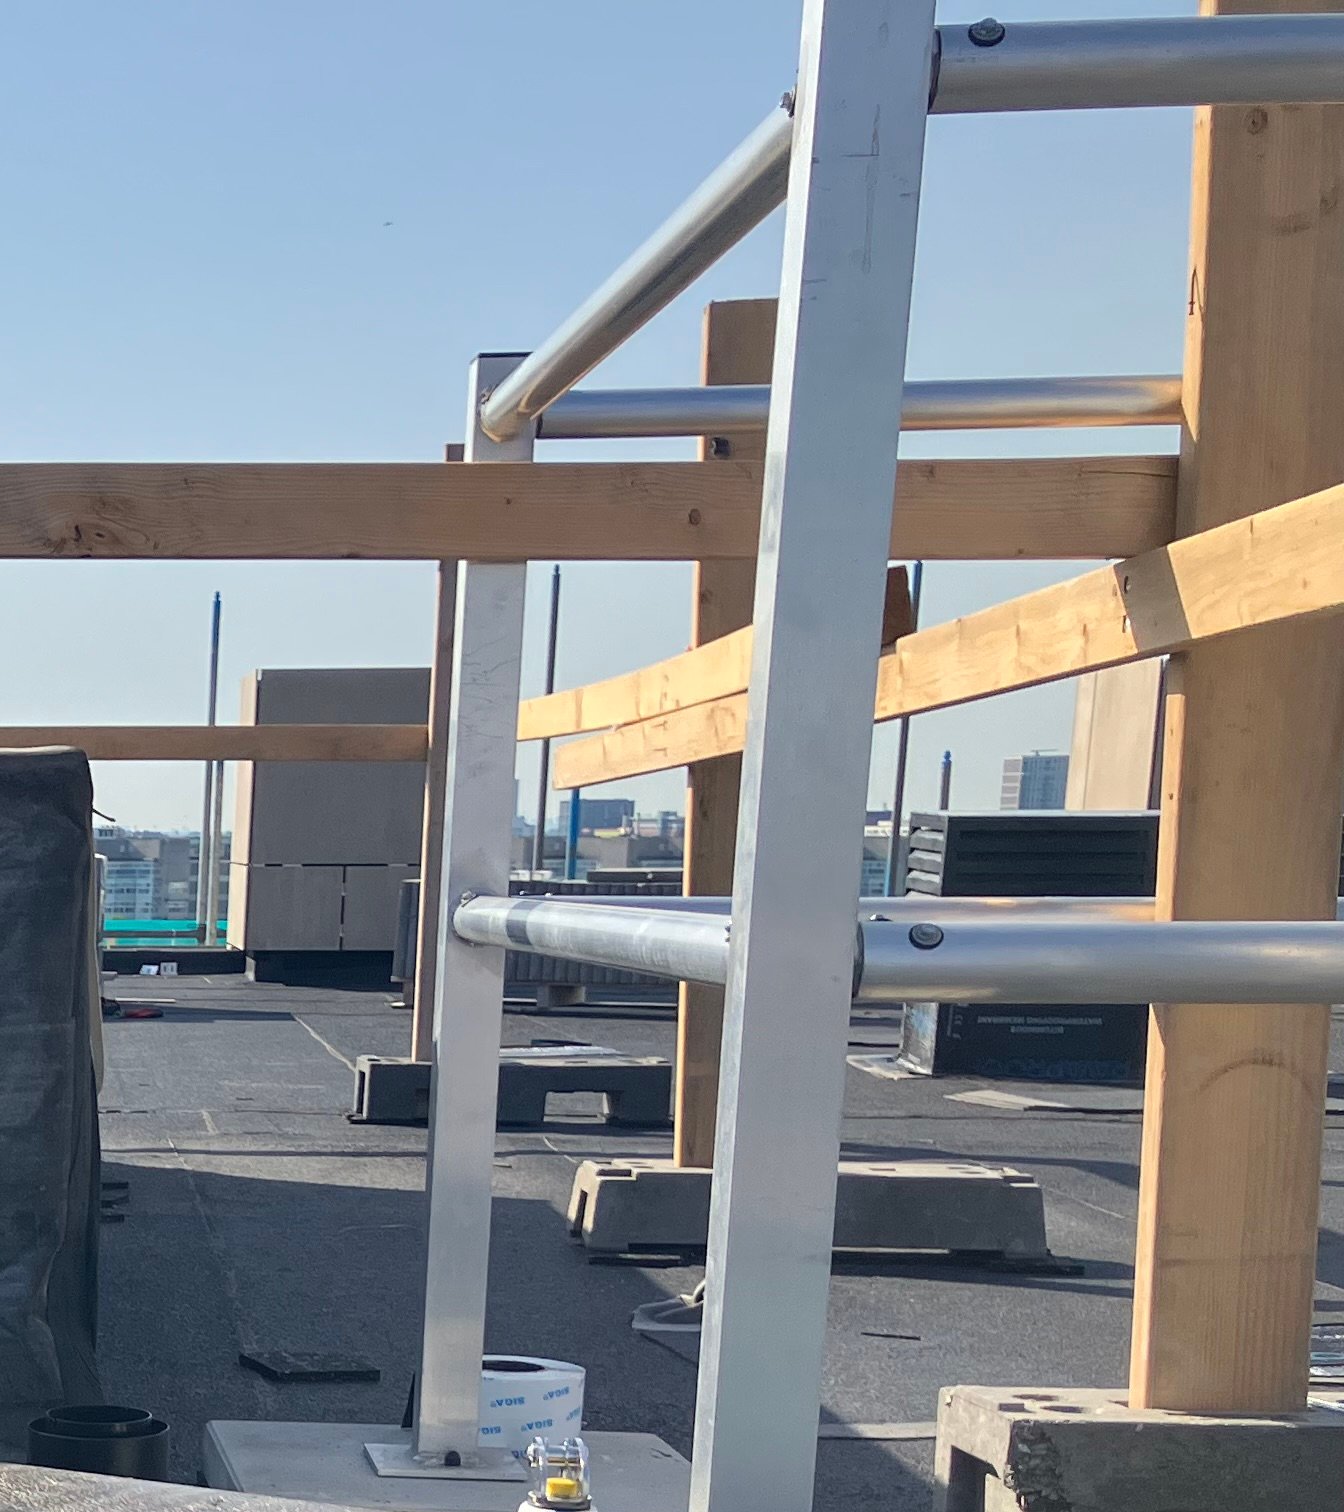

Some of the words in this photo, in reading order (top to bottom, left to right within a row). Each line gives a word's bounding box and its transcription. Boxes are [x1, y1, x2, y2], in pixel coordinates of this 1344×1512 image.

[495, 1397, 525, 1406] SIGA
[526, 1419, 553, 1430] SIGA
[480, 1426, 501, 1435] SIG
